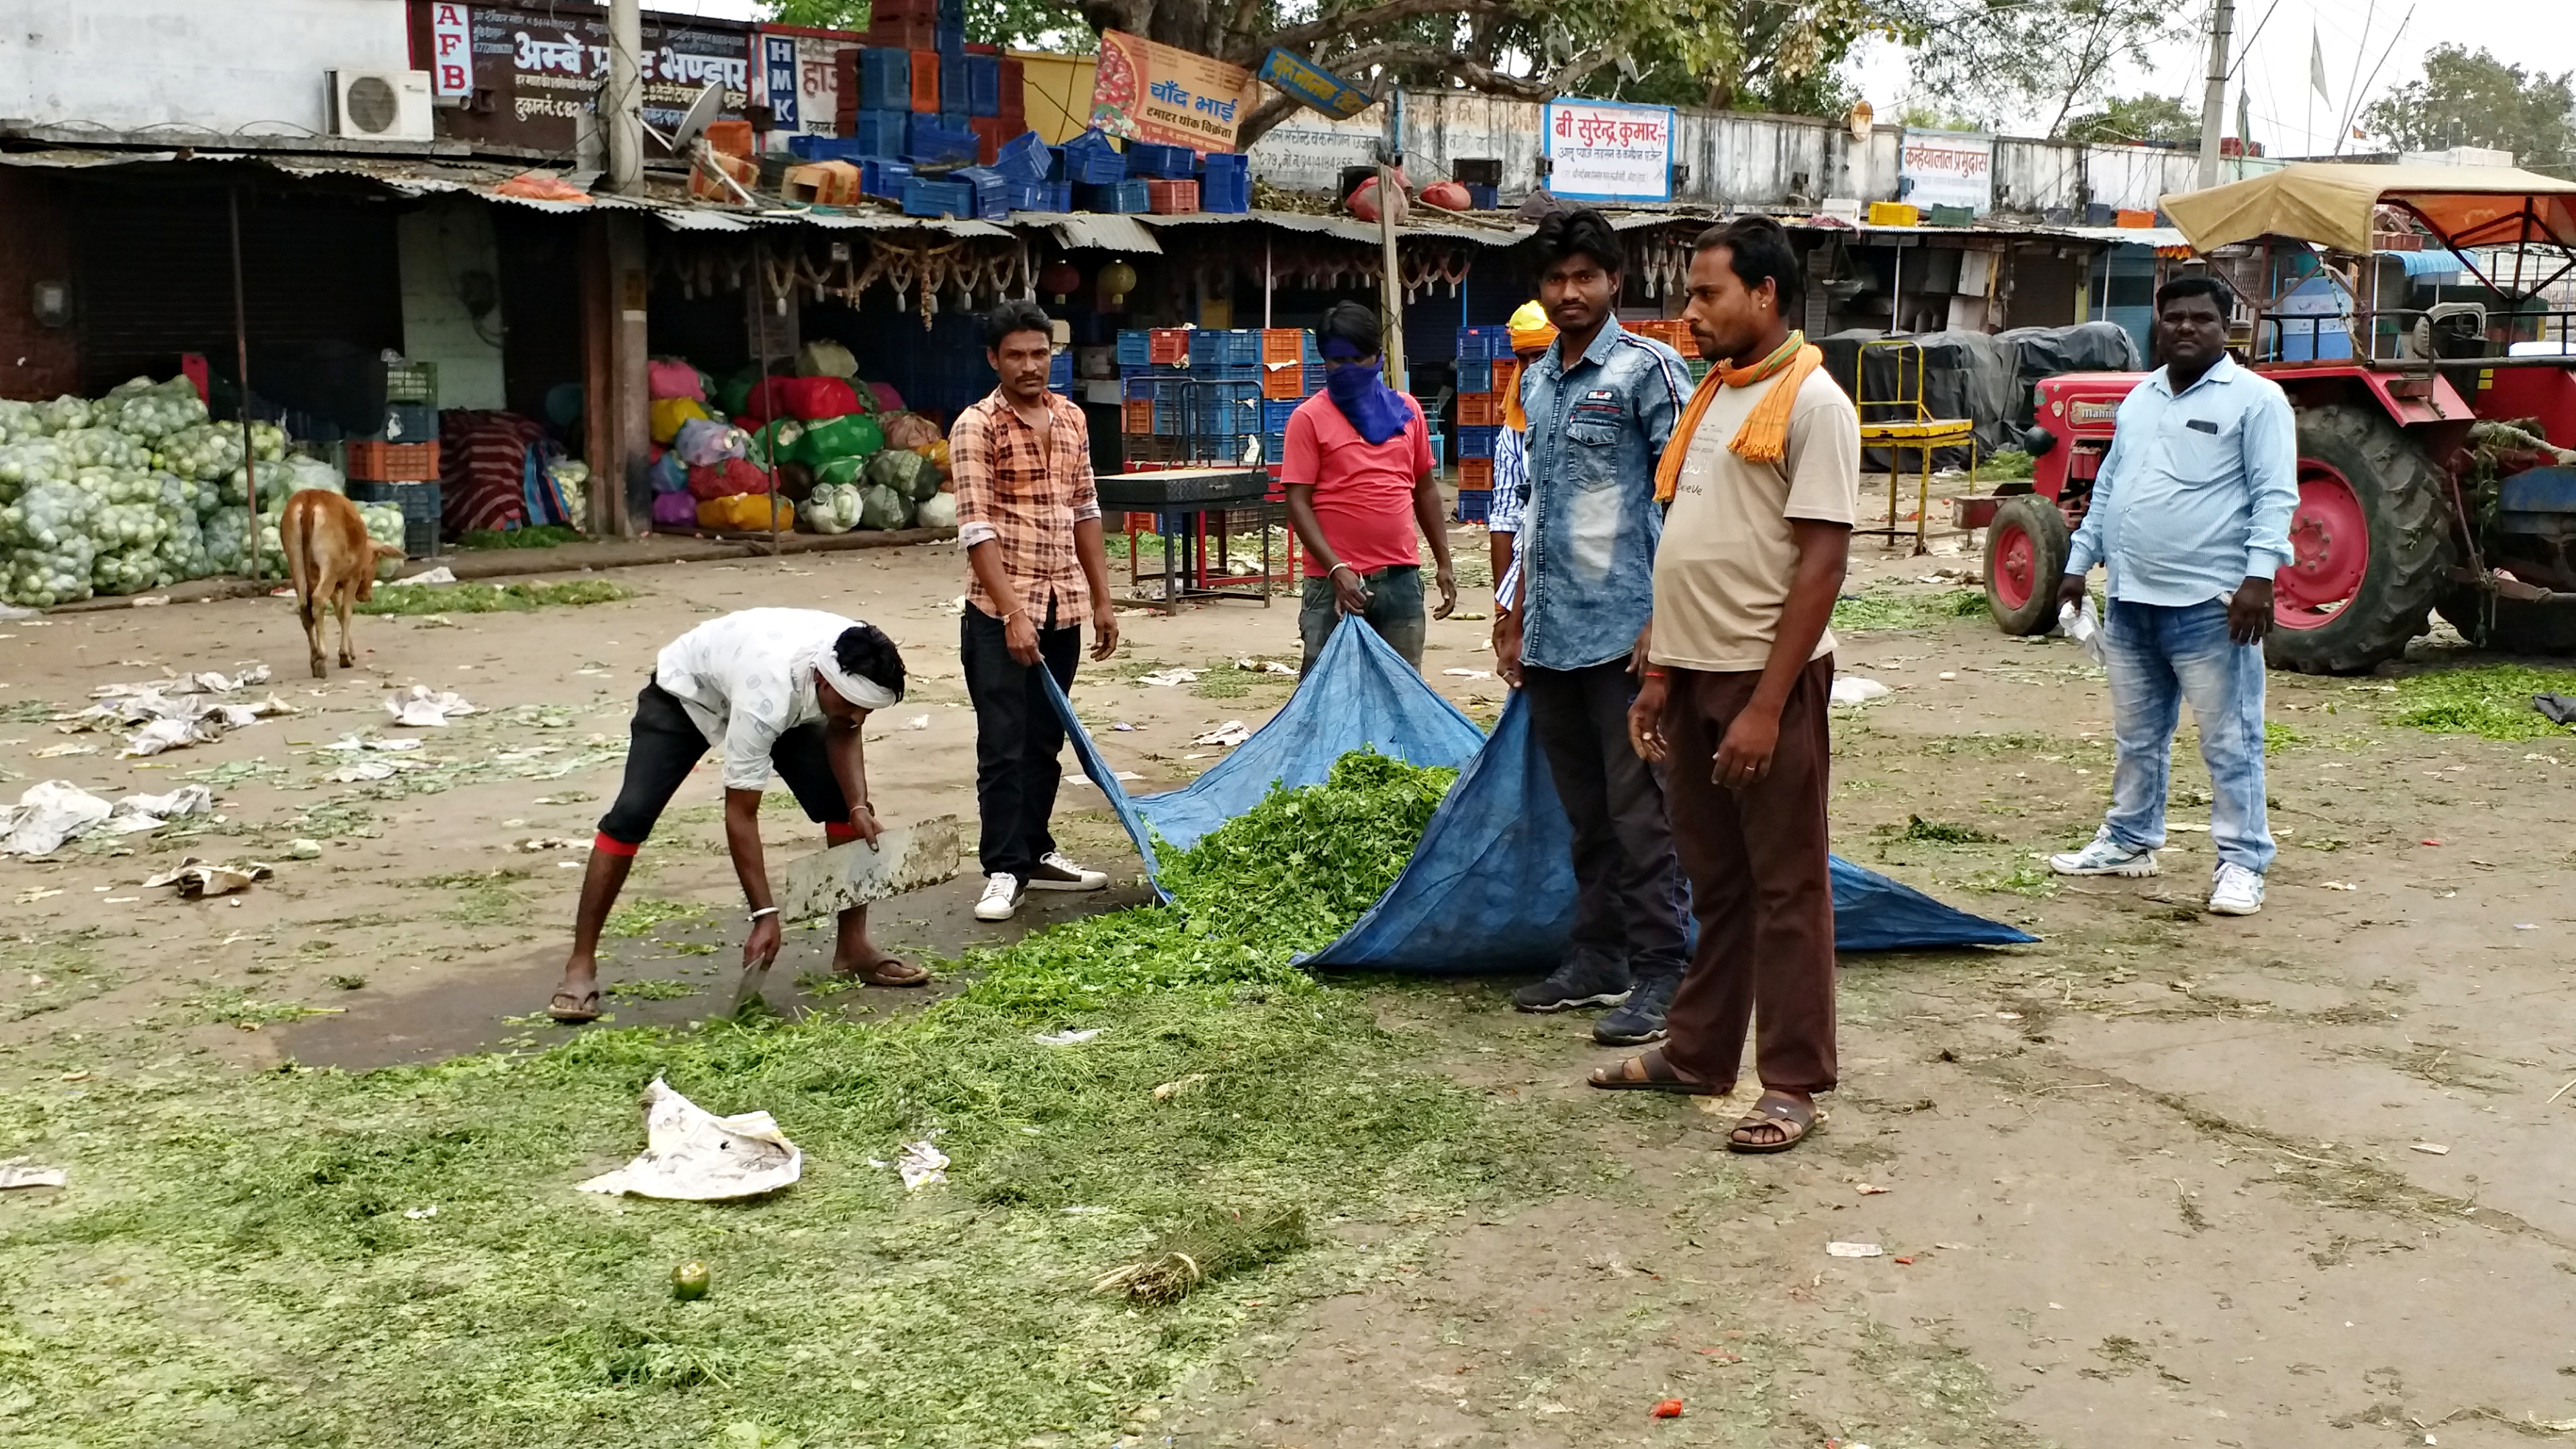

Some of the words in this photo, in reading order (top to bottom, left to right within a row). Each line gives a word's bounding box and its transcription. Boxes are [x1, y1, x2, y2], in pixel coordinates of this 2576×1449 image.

[1146, 106, 1176, 124] टमाटर
[1195, 95, 1238, 123] भाई
[1555, 110, 1574, 138] बी
[1620, 121, 1658, 148] कुमार
[1954, 150, 1988, 178] प्रभुदास
